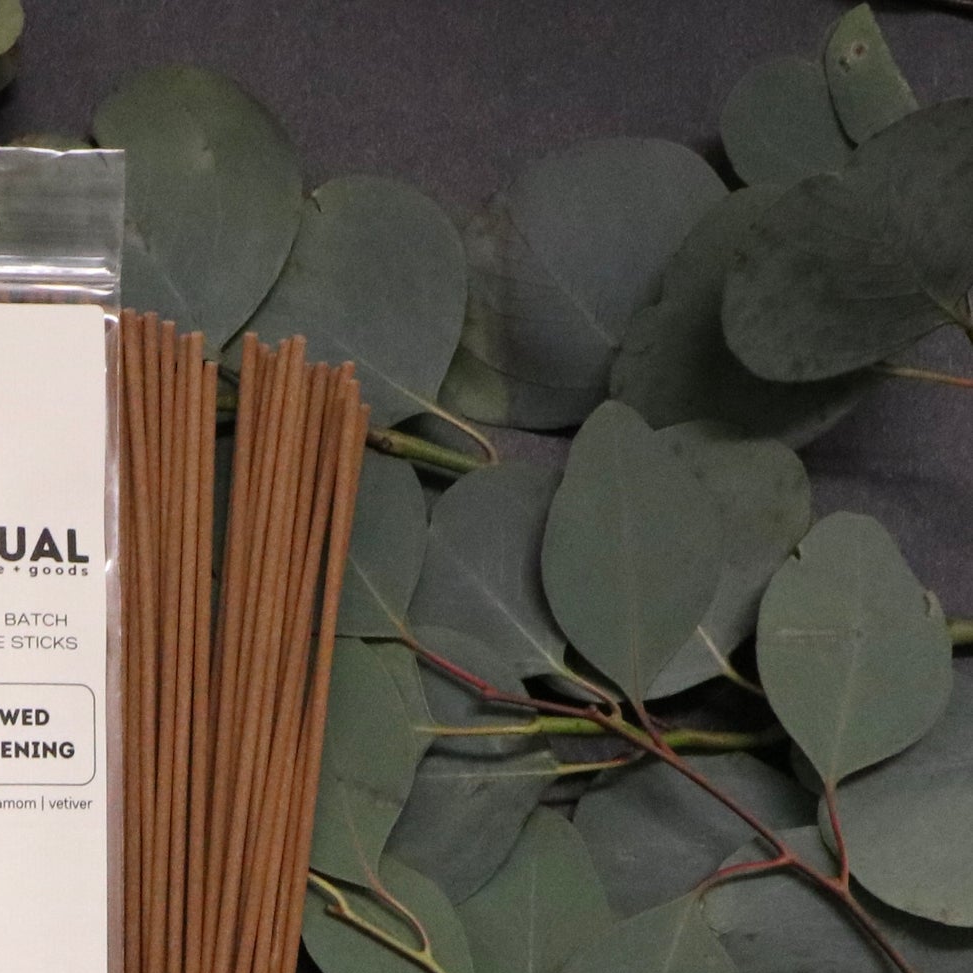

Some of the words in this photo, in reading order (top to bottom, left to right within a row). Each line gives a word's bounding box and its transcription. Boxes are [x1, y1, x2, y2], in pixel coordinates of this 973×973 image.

[29, 564, 88, 577] goods
[5, 613, 67, 627] BATCH
[11, 636, 78, 650] STICKS
[49, 797, 93, 809] vetiver
